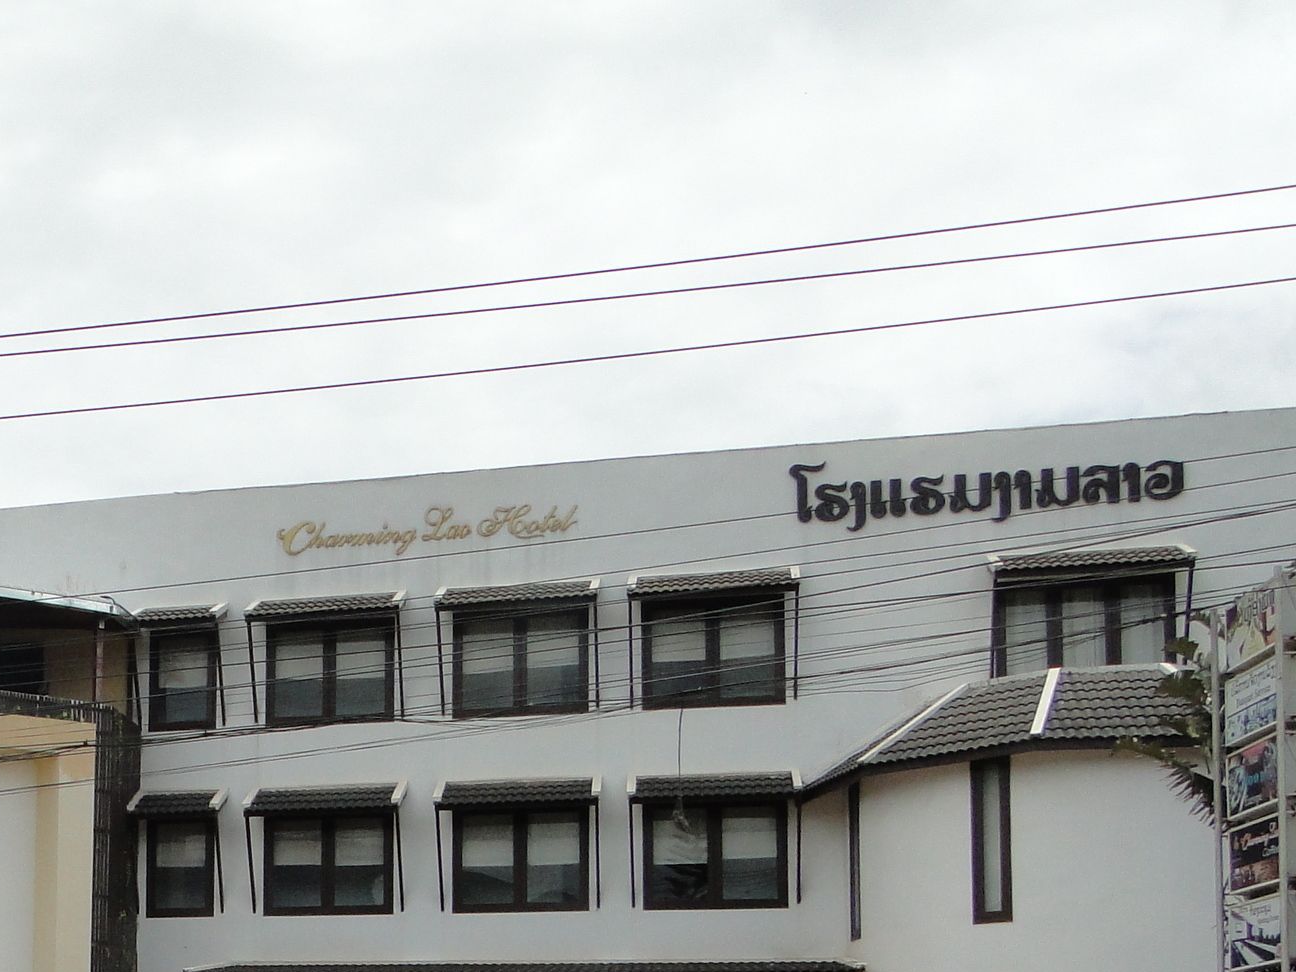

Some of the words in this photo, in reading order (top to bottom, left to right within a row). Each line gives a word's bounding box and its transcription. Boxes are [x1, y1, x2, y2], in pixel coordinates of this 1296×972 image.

[277, 521, 416, 556] Charming
[421, 503, 472, 541] Lao
[477, 504, 578, 539] Hotel
